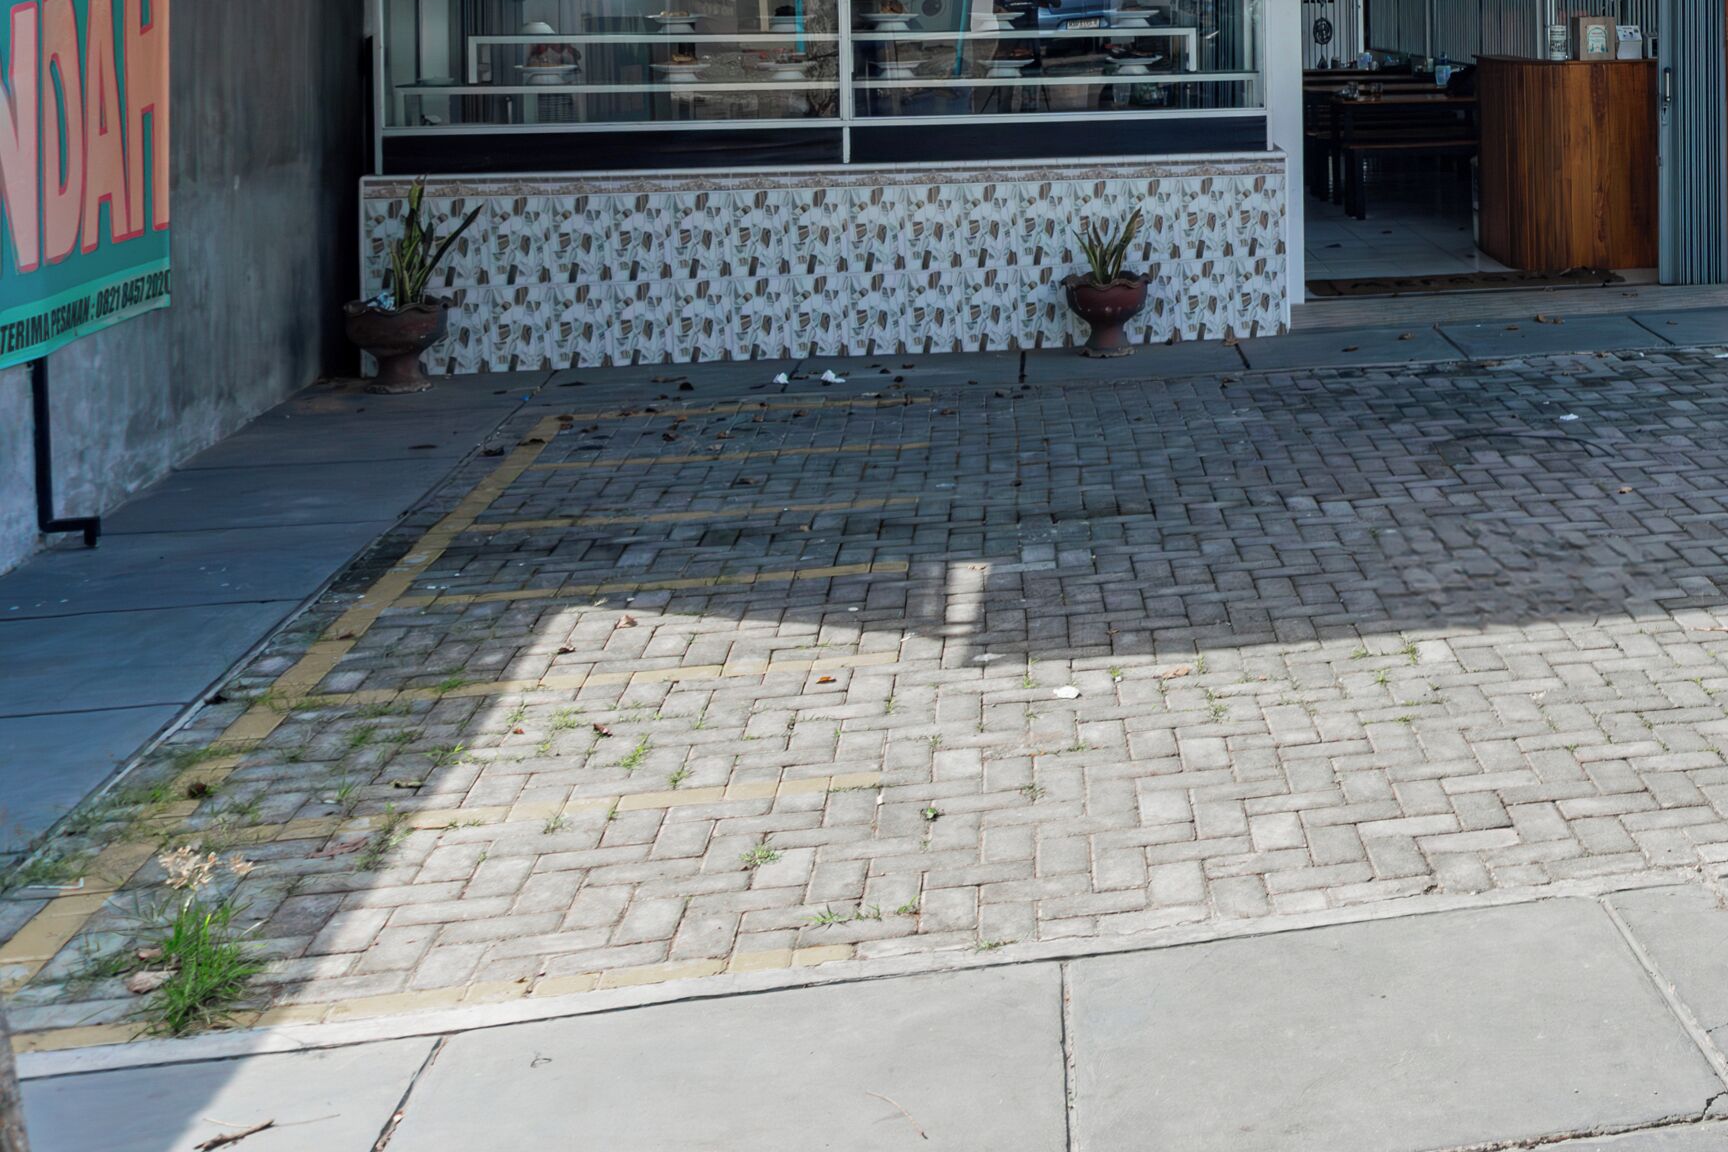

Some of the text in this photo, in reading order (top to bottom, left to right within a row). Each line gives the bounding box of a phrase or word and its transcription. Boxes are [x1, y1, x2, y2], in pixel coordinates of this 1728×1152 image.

[0, 312, 50, 355] TERIMA
[51, 295, 91, 336] PESANAN
[95, 289, 120, 319] 0821
[121, 277, 145, 308] 8457
